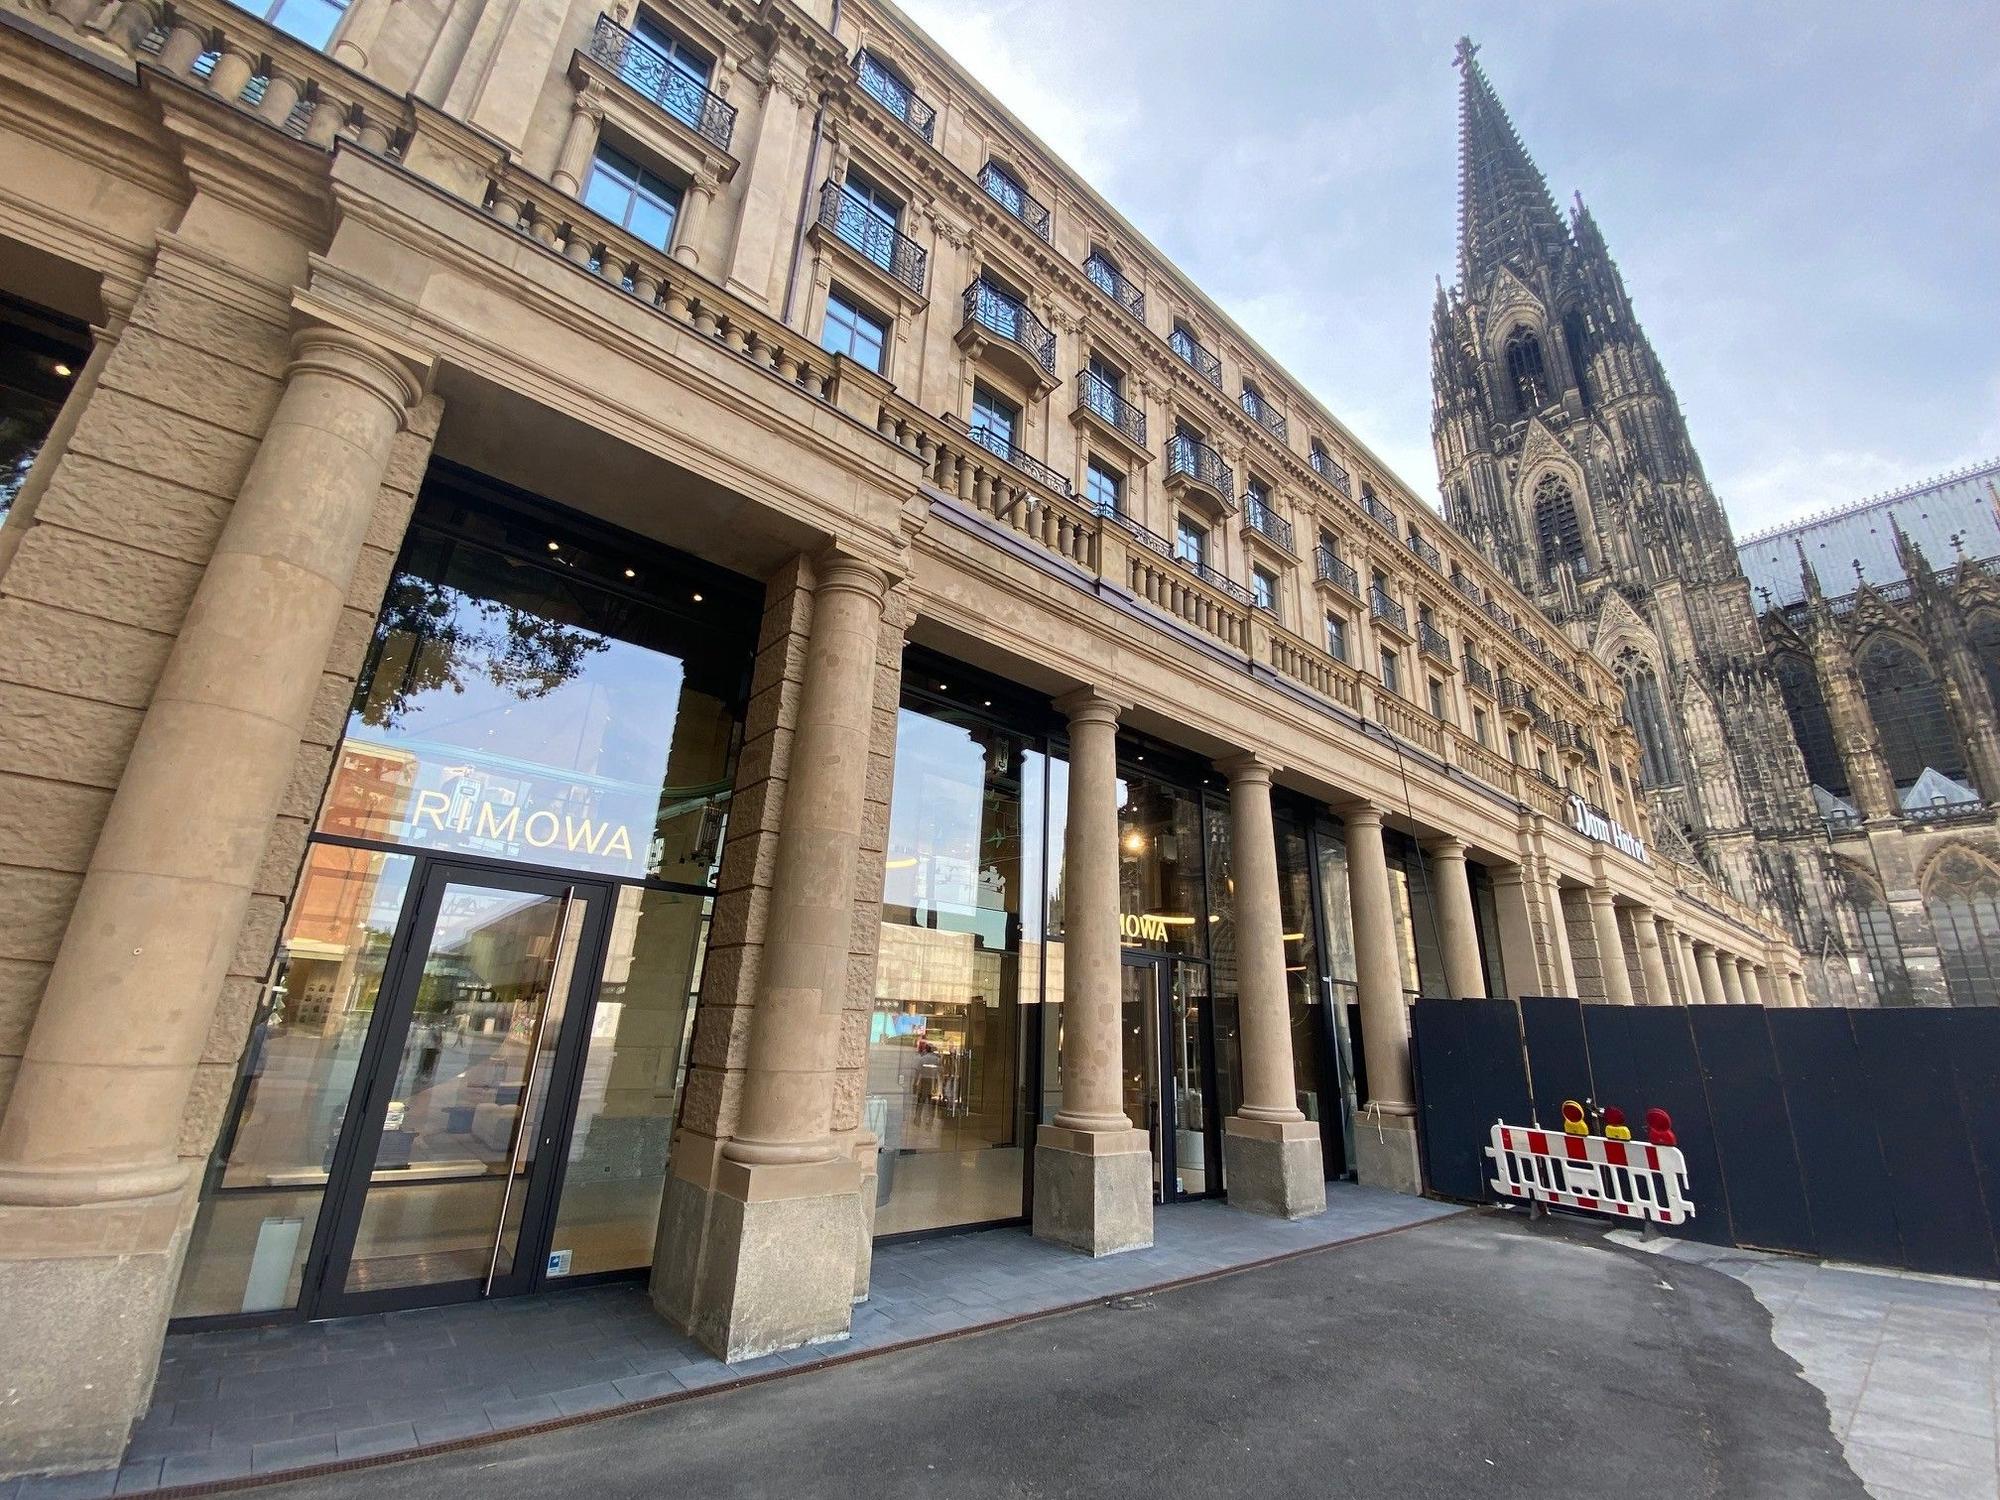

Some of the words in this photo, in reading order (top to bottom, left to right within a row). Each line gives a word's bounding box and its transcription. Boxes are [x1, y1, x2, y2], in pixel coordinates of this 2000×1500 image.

[412, 790, 633, 860] RIMOWA
[1567, 795, 1615, 845] Dom
[1611, 819, 1650, 864] Hotel
